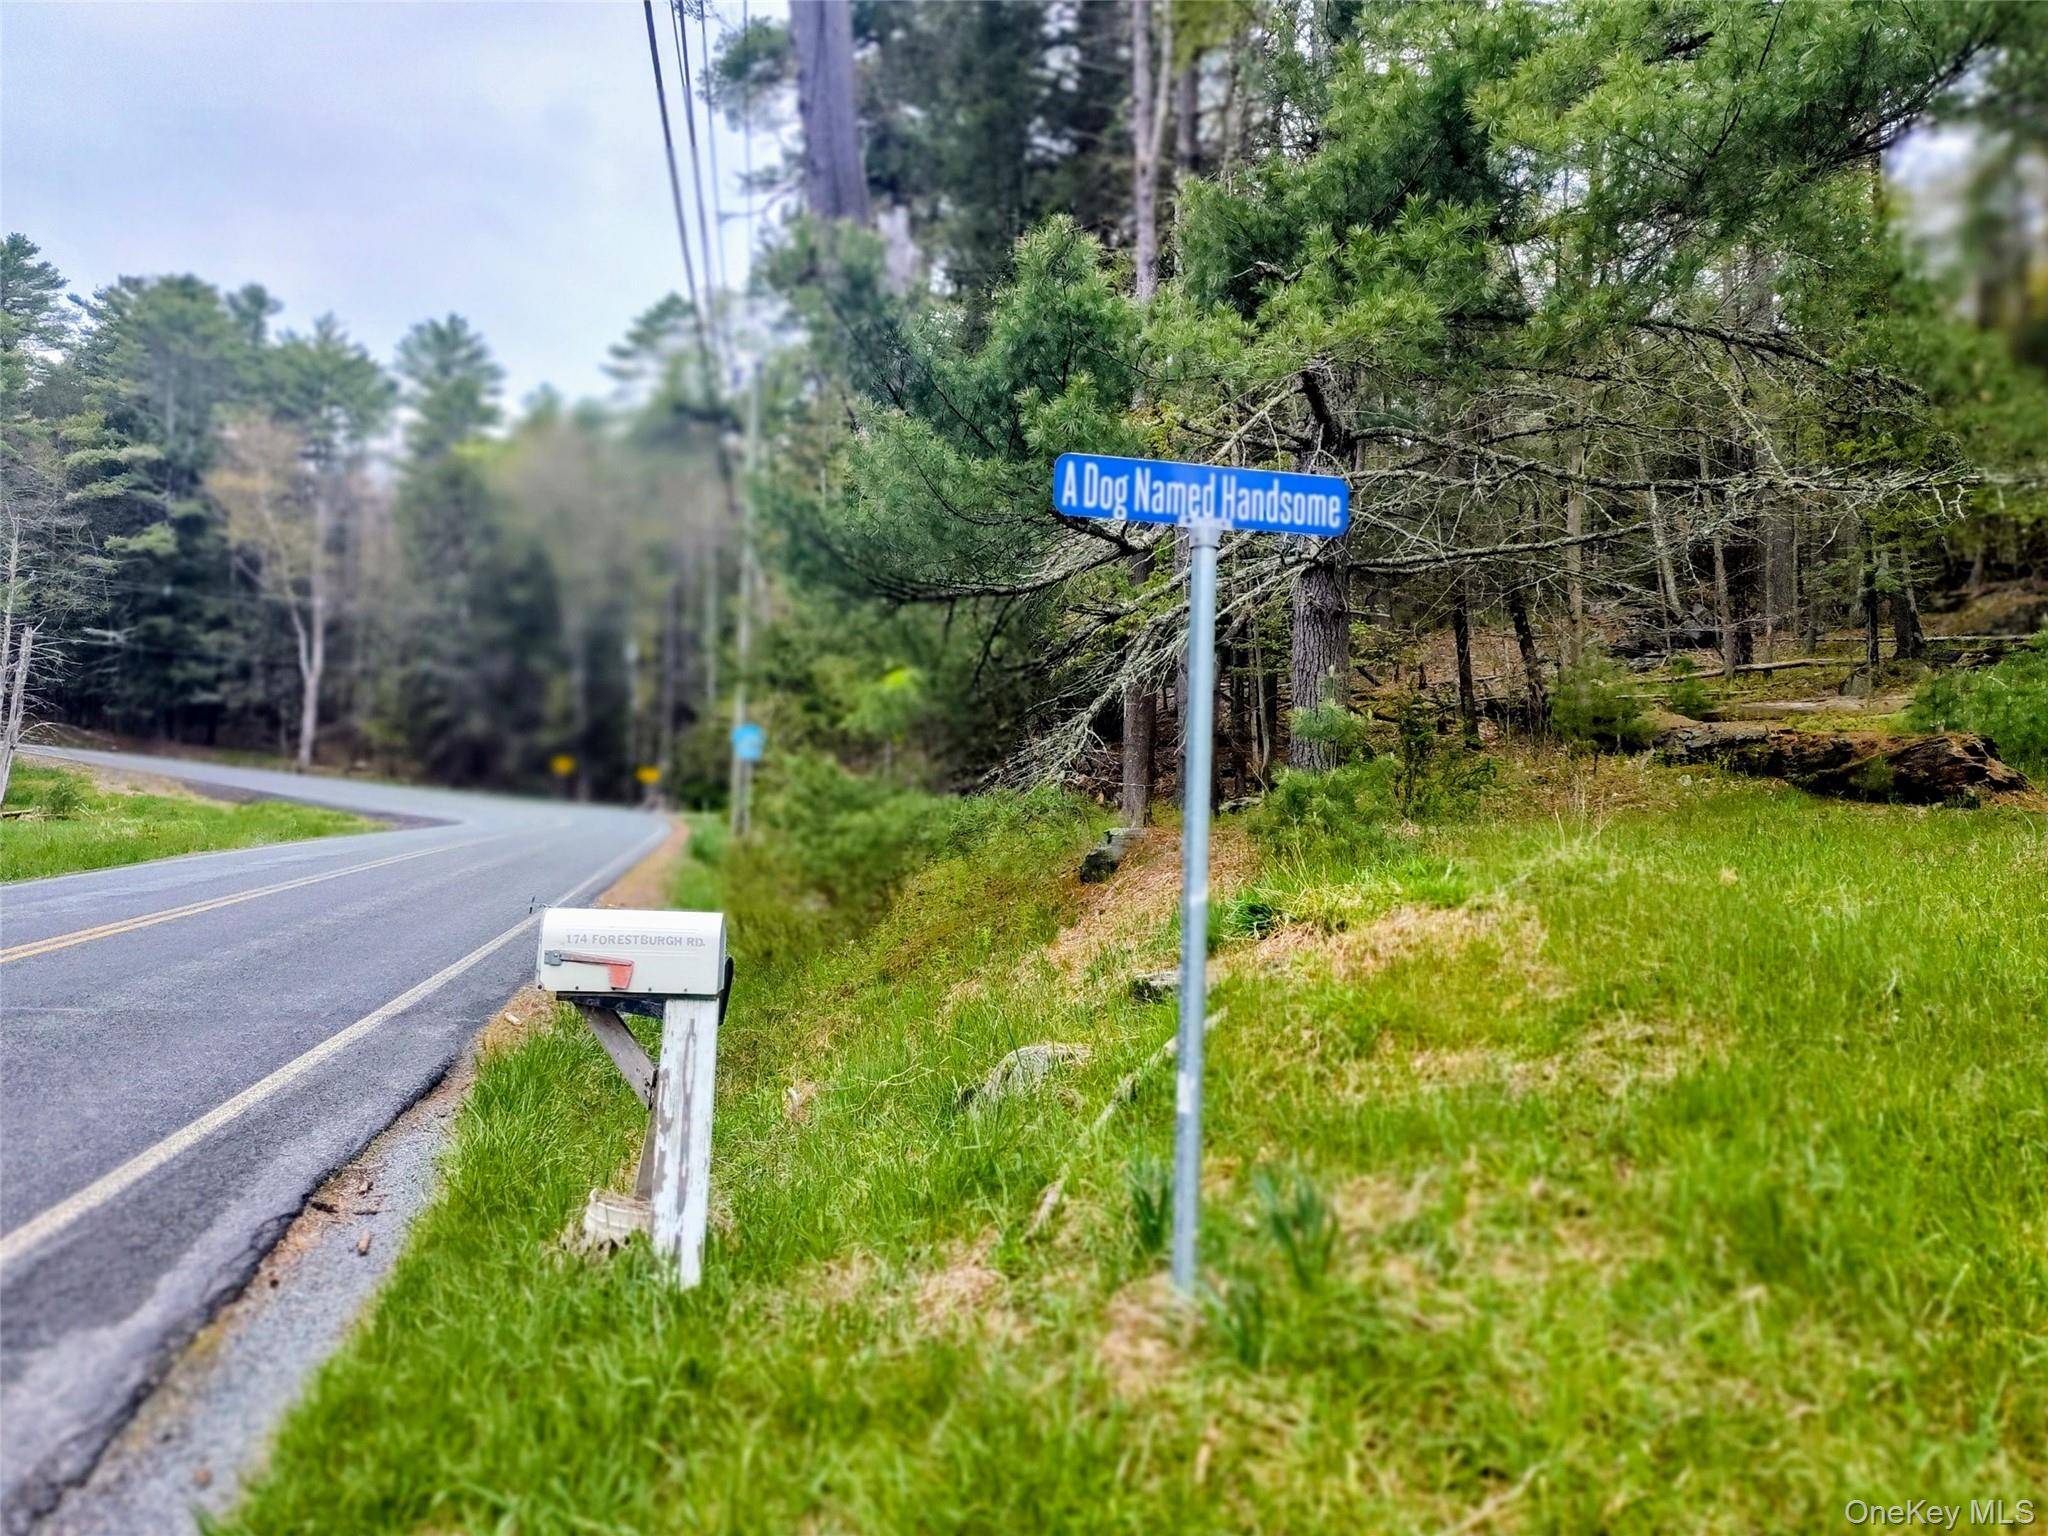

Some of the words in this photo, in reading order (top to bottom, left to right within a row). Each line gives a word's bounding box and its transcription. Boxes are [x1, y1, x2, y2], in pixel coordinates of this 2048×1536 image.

[1061, 460, 1078, 507] A
[1083, 462, 1129, 520] Dog
[1134, 467, 1215, 519] Named
[1221, 475, 1341, 528] Handsome
[566, 934, 588, 945] 174
[592, 934, 683, 946] FORESTBURGH
